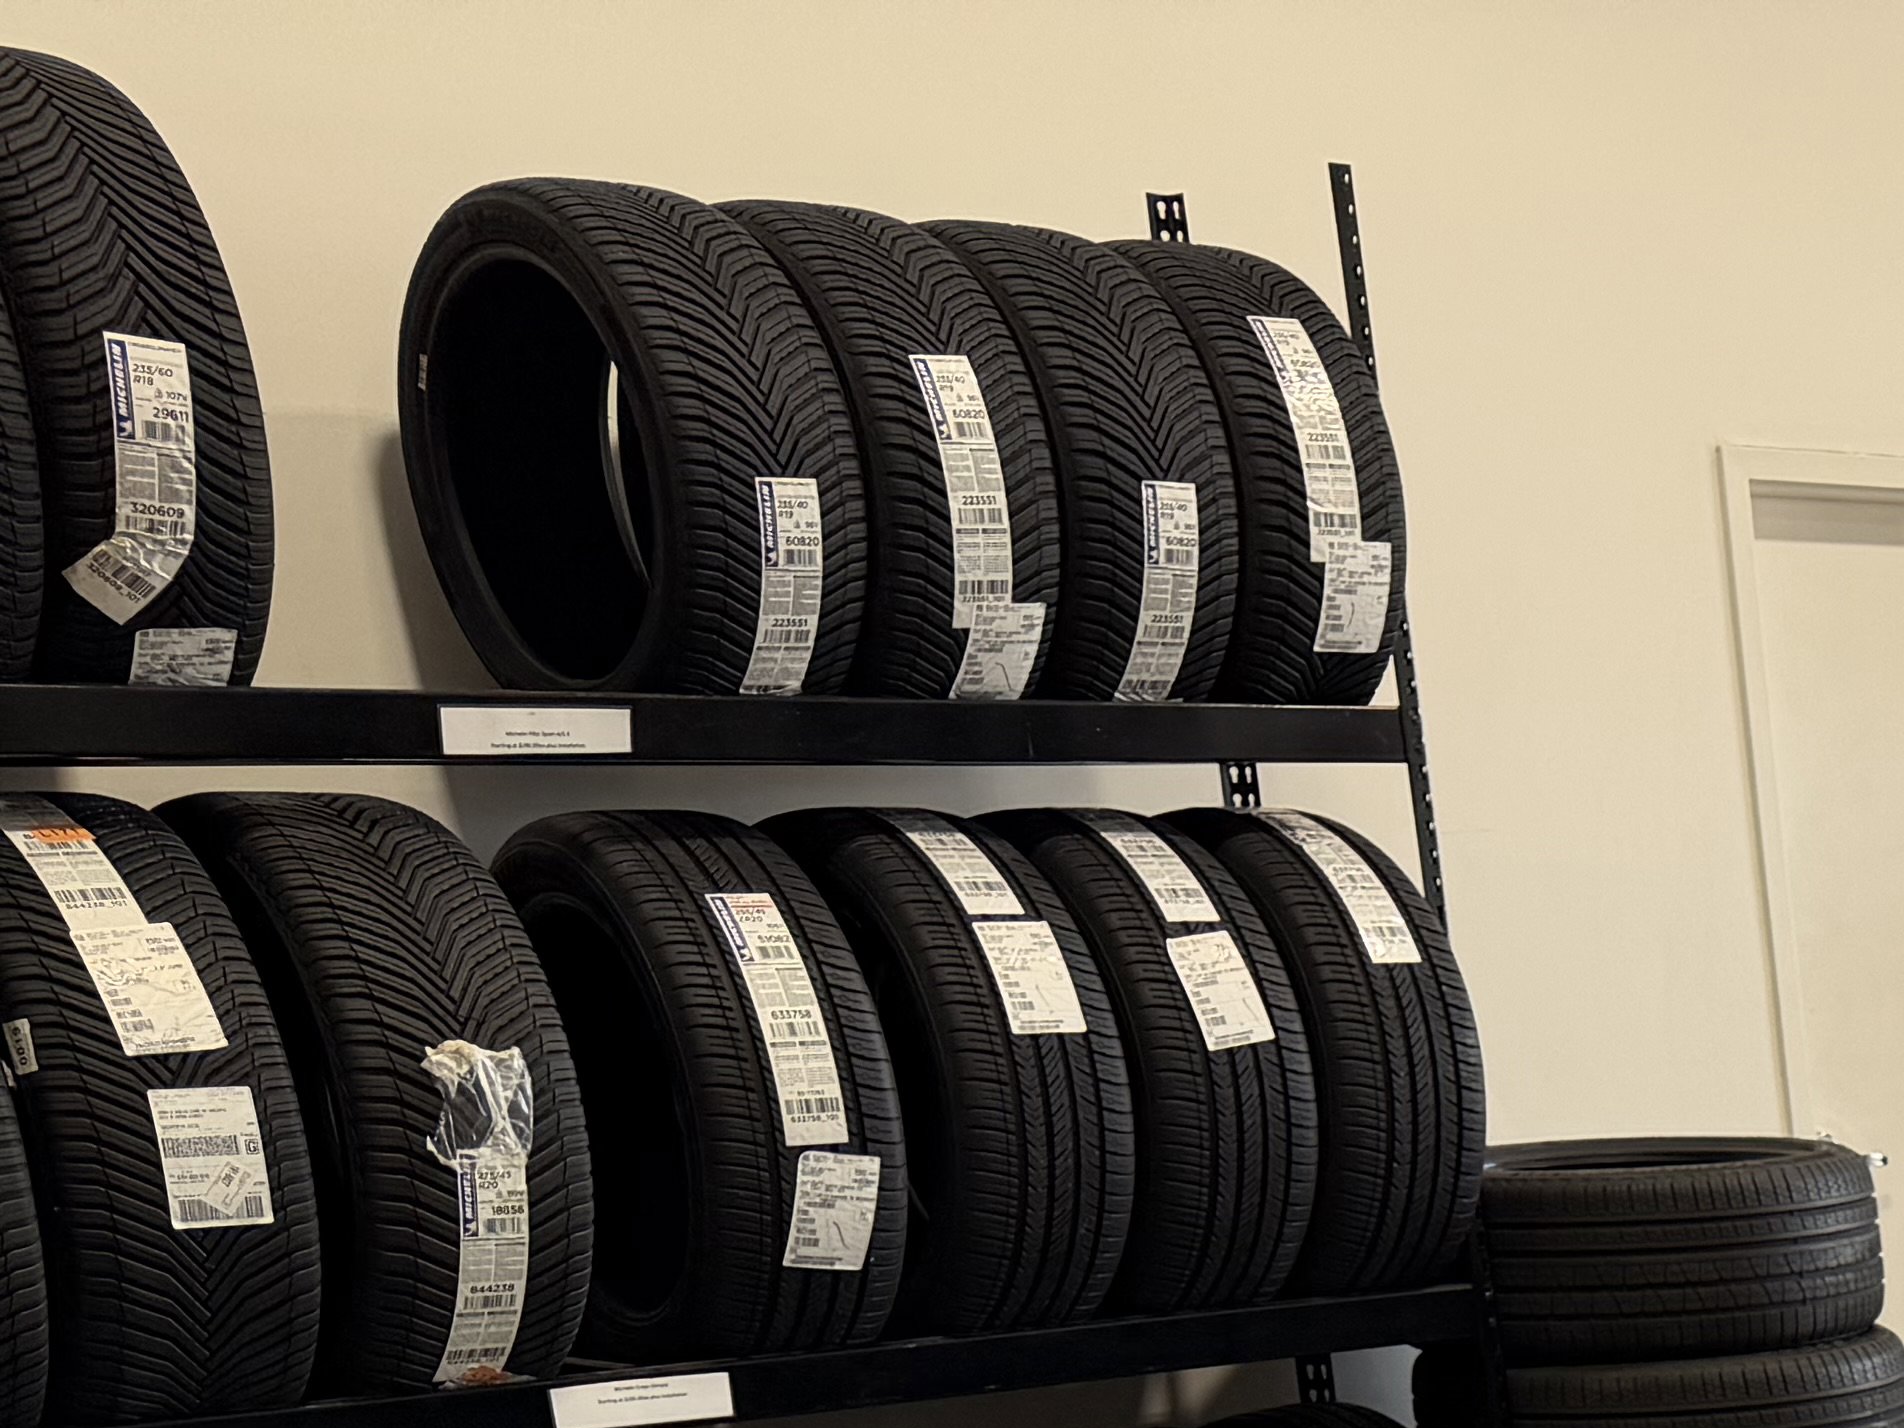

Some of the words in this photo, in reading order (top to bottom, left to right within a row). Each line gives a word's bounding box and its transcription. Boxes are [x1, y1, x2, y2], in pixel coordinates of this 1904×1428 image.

[132, 363, 174, 378] 235/60
[111, 342, 129, 417] MICHELIN
[130, 502, 185, 519] 320609
[761, 484, 775, 549] MICHELIN
[770, 1009, 812, 1020] 633758
[469, 1284, 515, 1294] 844238
